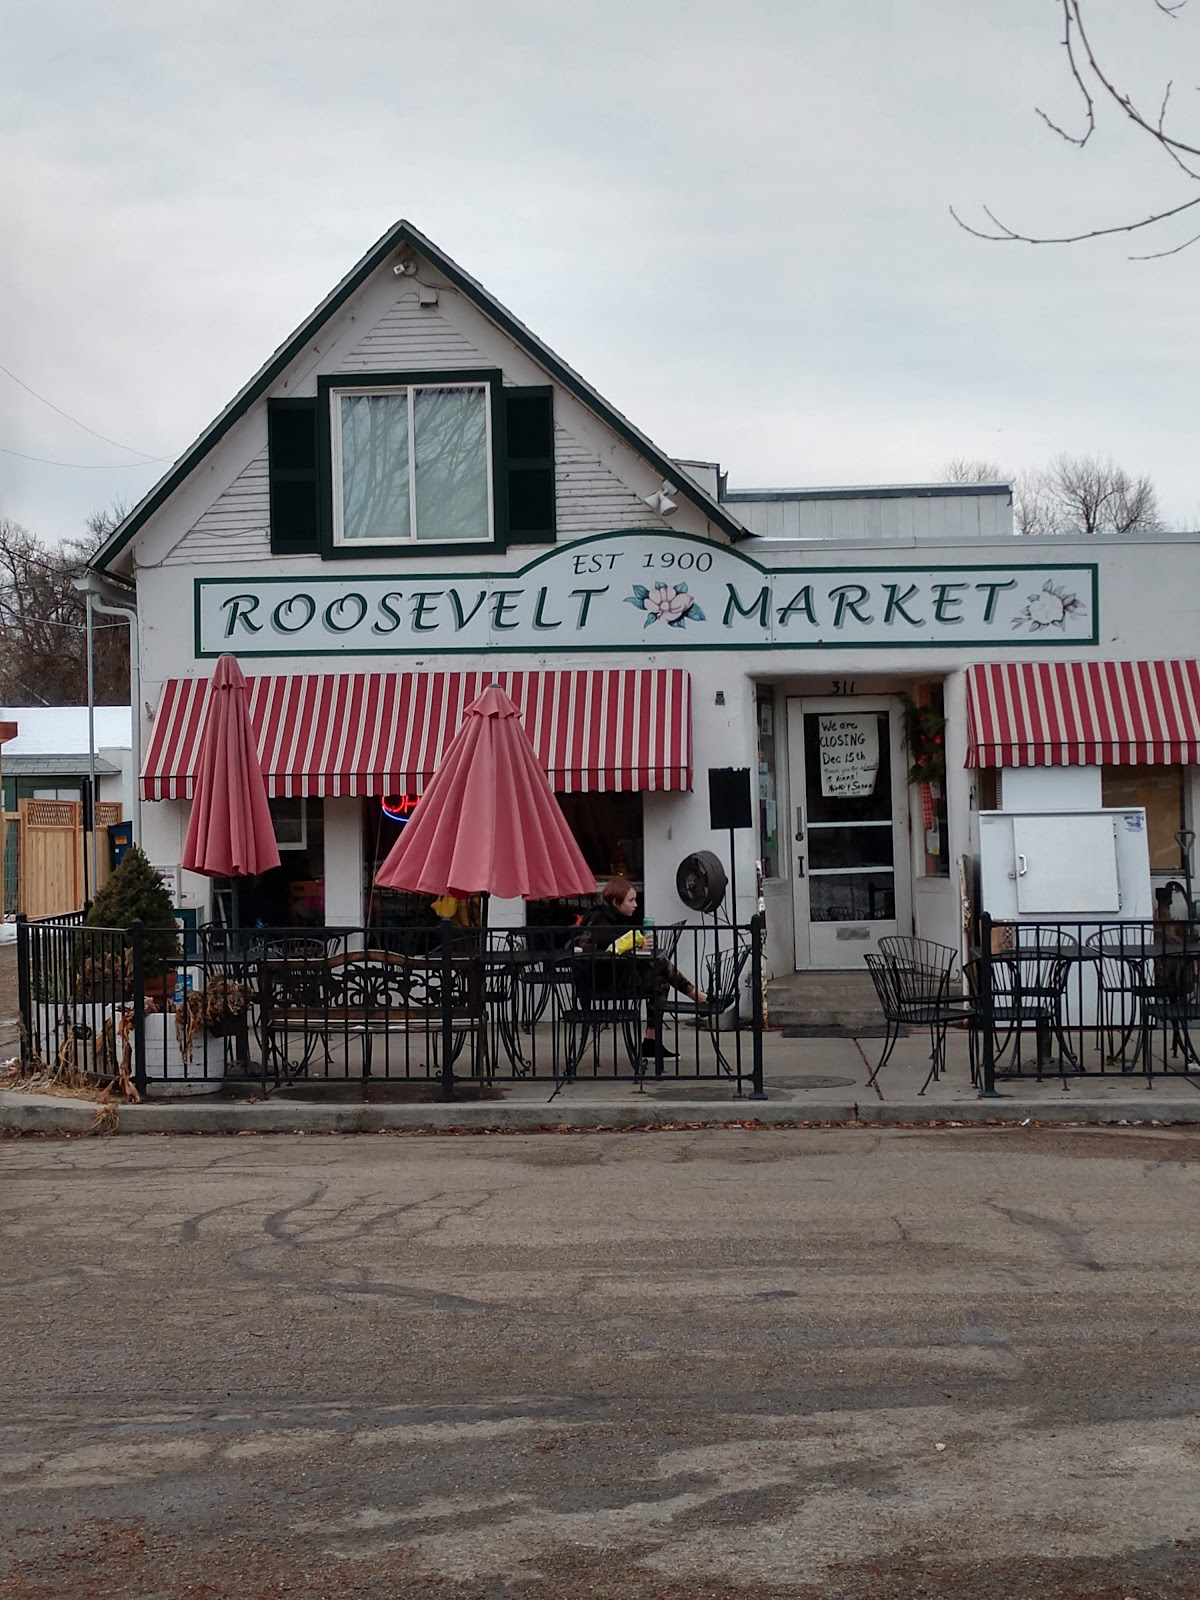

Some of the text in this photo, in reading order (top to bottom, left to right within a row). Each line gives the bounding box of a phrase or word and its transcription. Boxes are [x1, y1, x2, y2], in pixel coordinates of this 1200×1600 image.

[572, 552, 713, 574] EST 1900
[220, 578, 1017, 638] ROOSEVELT MARKET
[831, 680, 855, 694] 311
[821, 720, 858, 732] We are
[819, 733, 866, 748] CLOSING
[822, 752, 841, 765] Dec
